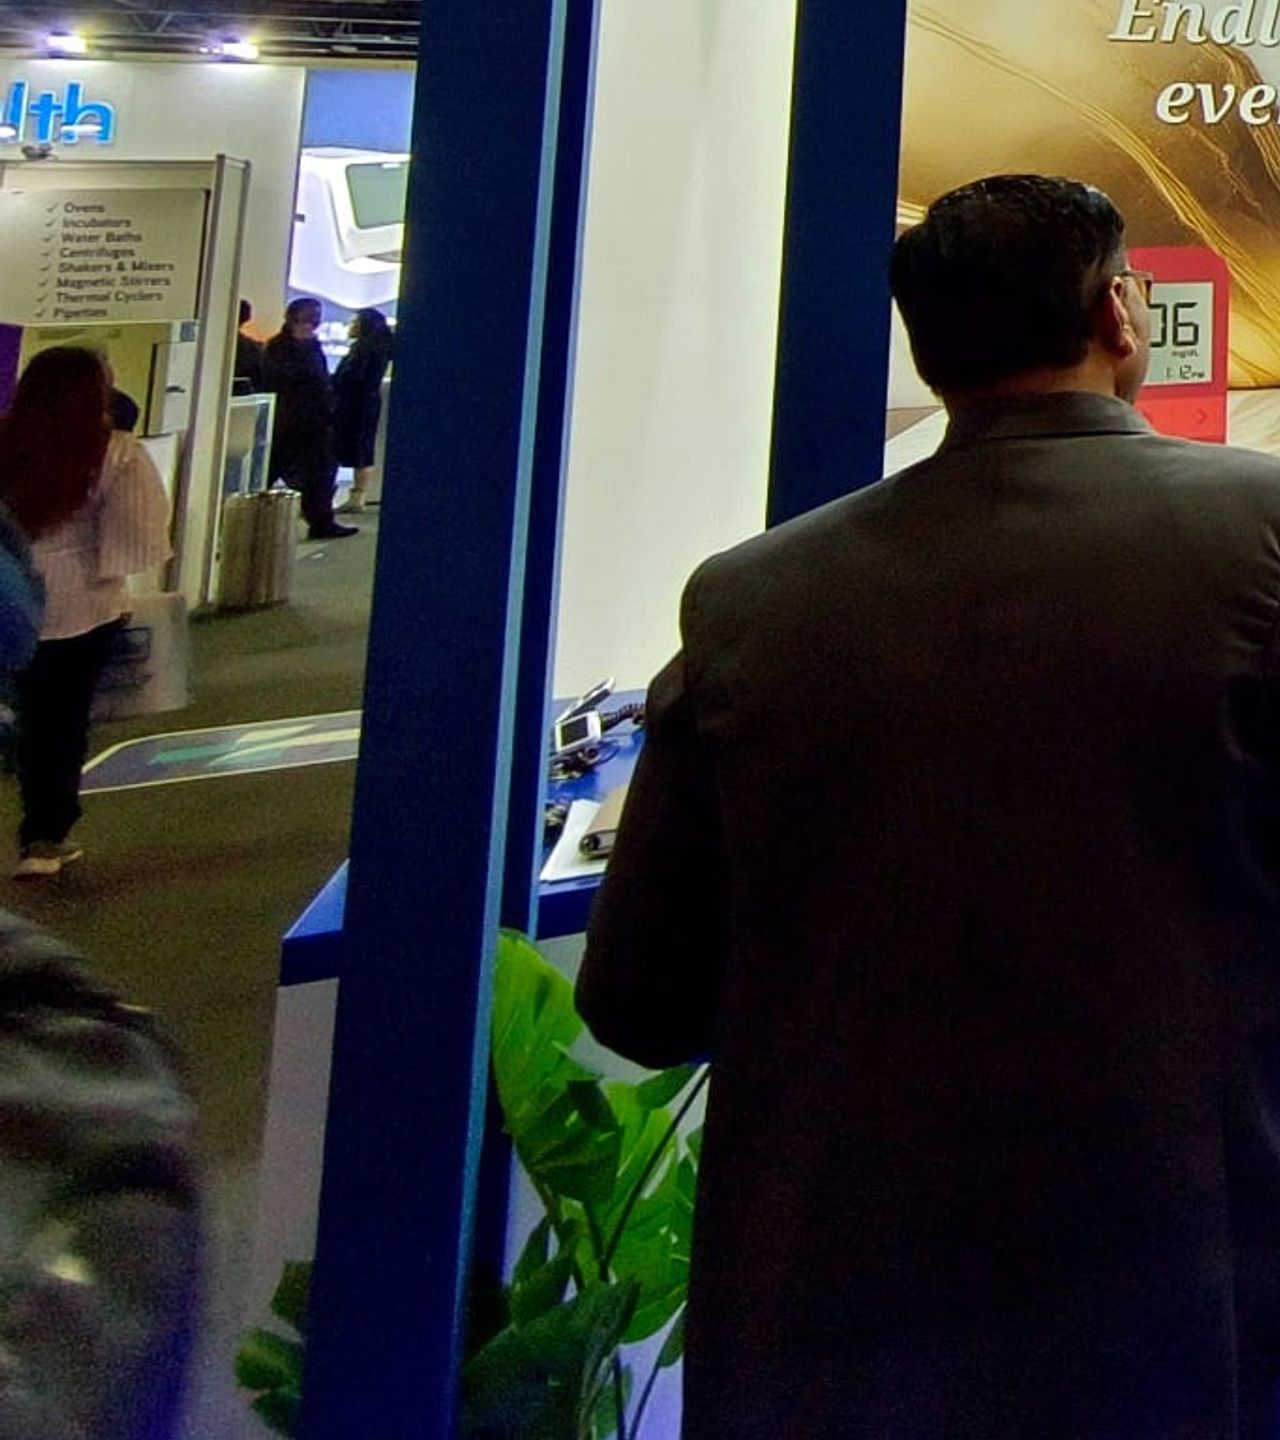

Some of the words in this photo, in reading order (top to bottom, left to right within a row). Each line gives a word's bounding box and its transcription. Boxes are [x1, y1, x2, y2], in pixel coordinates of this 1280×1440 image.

[0, 81, 113, 143] lth
[63, 202, 105, 213] Ovens
[62, 218, 131, 228] Incubators
[61, 233, 100, 242] Water
[105, 232, 142, 242] Baths
[60, 247, 135, 259] Centrifuges
[58, 262, 112, 273] Shakers
[116, 262, 126, 271] &
[132, 261, 175, 271] Mixers
[56, 277, 116, 289] Magnetic
[120, 276, 171, 286] Stirrers
[56, 292, 110, 303] Thermal
[115, 291, 163, 303] Cyclers
[53, 308, 107, 319] Pipettes
[1148, 302, 1199, 348] 06
